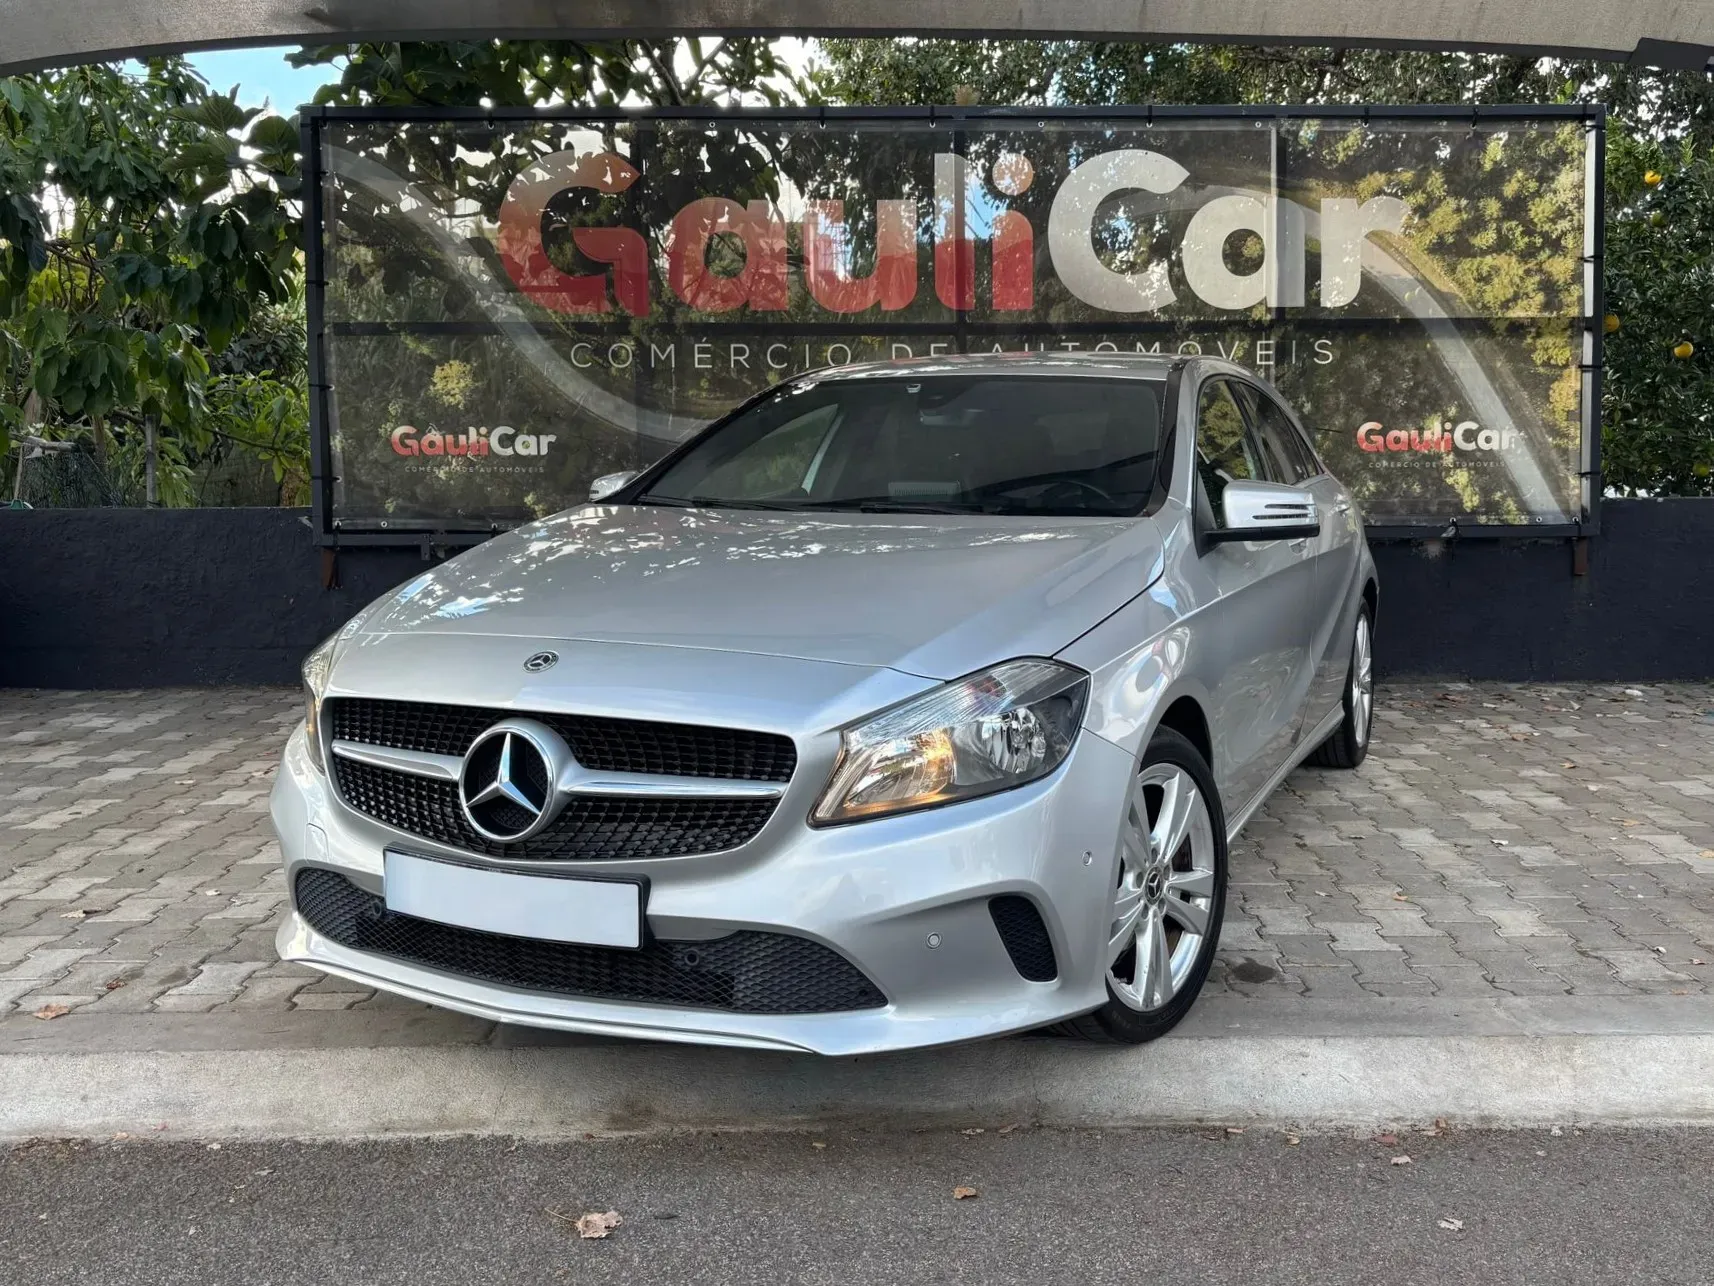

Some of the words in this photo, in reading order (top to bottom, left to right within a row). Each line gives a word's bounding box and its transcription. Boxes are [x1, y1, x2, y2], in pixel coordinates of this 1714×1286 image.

[499, 149, 1409, 317] GauliCar
[570, 337, 851, 369] COMÉRCIO
[390, 425, 557, 457] GauliCar
[1356, 421, 1521, 453] GauliCar
